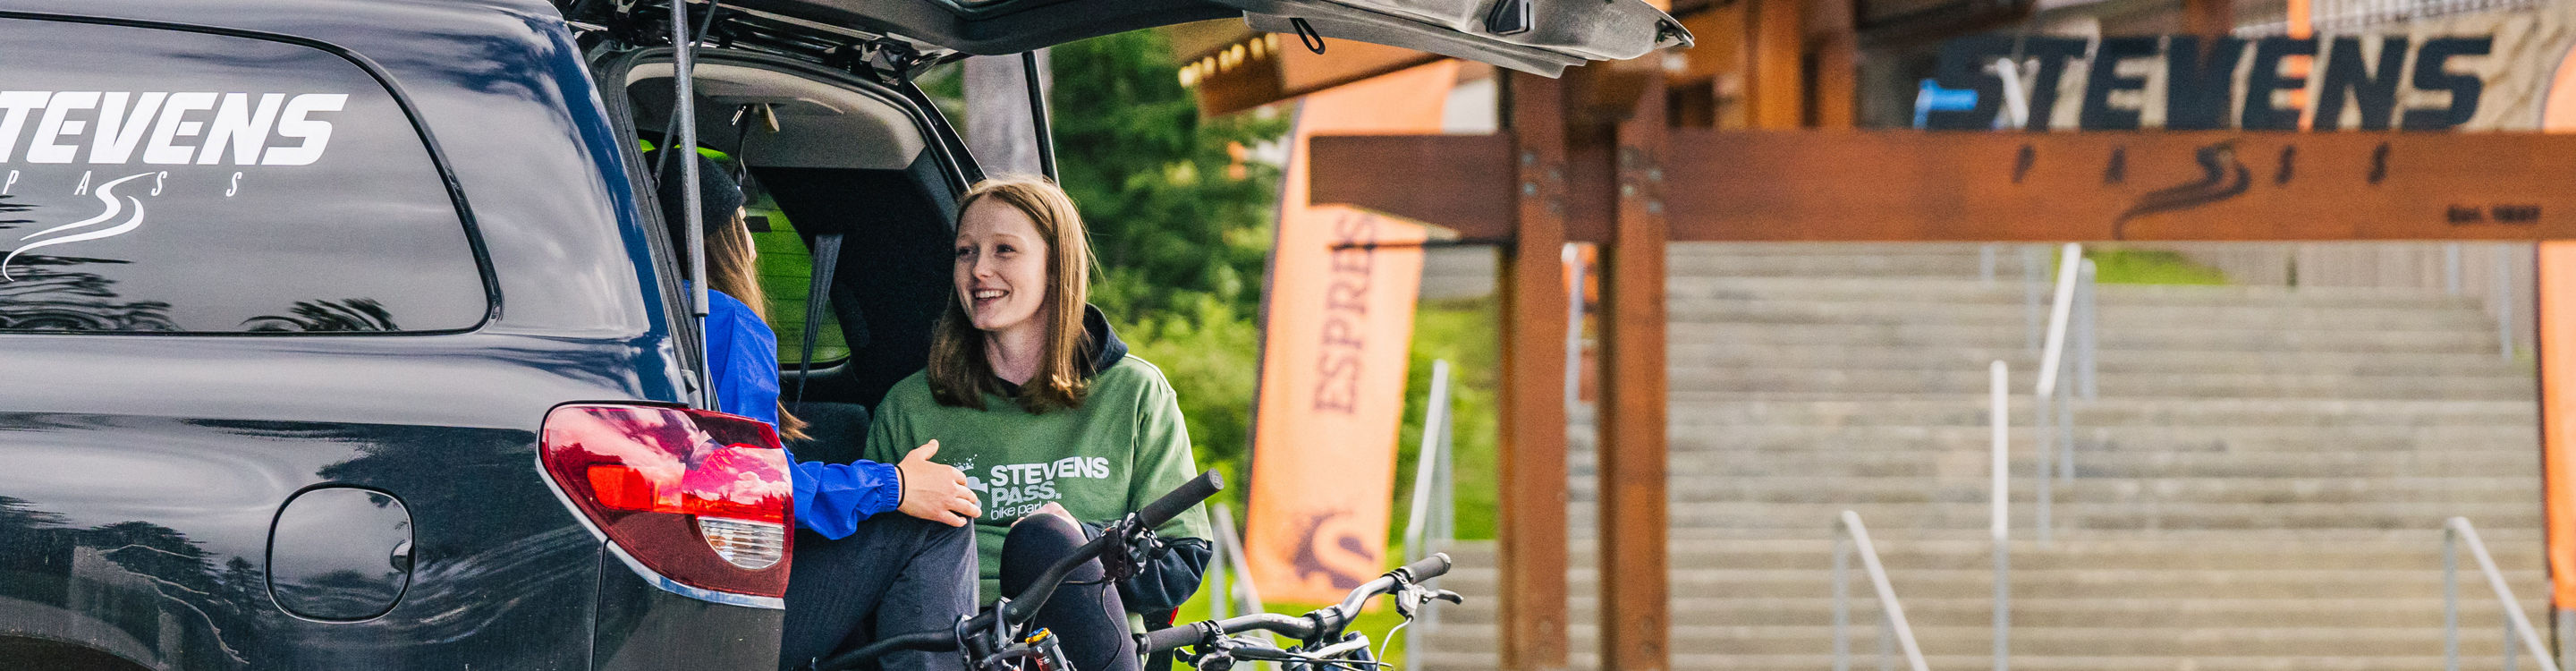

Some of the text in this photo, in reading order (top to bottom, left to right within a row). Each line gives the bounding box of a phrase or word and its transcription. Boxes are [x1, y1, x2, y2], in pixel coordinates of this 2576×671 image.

[1923, 34, 2494, 132] STEVENS
[989, 456, 1110, 488] STEVENS
[990, 506, 1016, 521] bike
